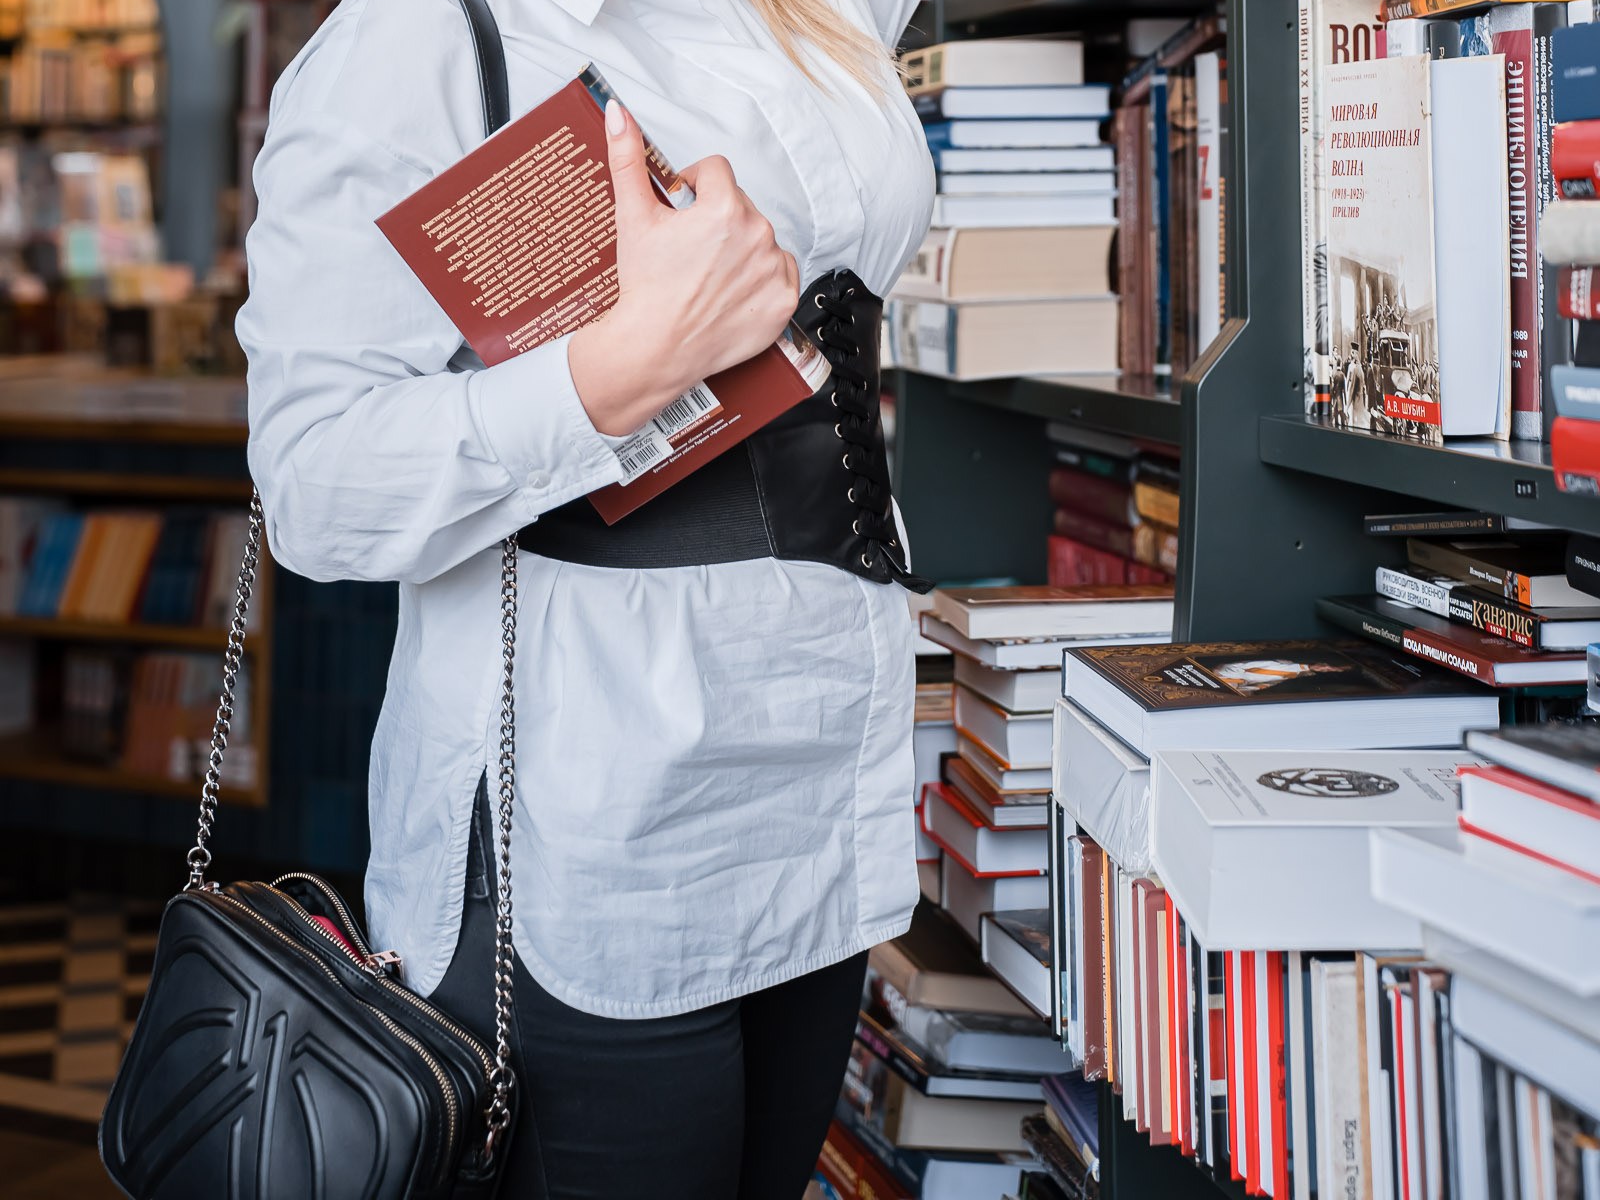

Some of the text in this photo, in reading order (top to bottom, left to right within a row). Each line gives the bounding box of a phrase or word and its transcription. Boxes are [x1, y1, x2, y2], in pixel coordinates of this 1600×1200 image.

[1387, 2, 1413, 20] МАФИЯ
[1299, 8, 1309, 60] ВОЙНЫ
[1301, 96, 1309, 133] ВЕКА
[1330, 103, 1378, 122] МИРОВАЯ
[1330, 128, 1421, 149] РЕВОЛЮЦИОННАЯ
[1541, 94, 1550, 180] принудительное
[420, 207, 451, 231] Аристотель
[455, 193, 471, 206] один
[476, 166, 510, 192] величайших
[507, 143, 541, 169] мыслителей
[539, 125, 570, 148] древности,
[426, 220, 446, 238] ученик
[443, 205, 469, 224] Платона
[471, 180, 505, 205] воспитатель
[503, 158, 535, 183] Александра
[532, 132, 574, 162] Македонского,
[1332, 160, 1364, 177] ВОЛНА
[1508, 60, 1528, 279] ЭНЦИКЛОПЕДИЯ
[433, 218, 477, 253] древнегреческой
[475, 198, 507, 223] философии
[510, 174, 540, 198] оказавший
[538, 158, 564, 179] огромное
[563, 143, 587, 162] влияние
[436, 212, 471, 240] обобщивший
[473, 200, 491, 214] своих
[488, 187, 509, 202] трудах
[507, 177, 522, 190] опыт
[521, 152, 558, 181] классической
[556, 141, 574, 156] эпохи
[462, 221, 488, 242] развитие
[486, 198, 520, 225] европейской
[523, 179, 548, 200] мировой
[544, 162, 575, 183] культуры,
[1332, 206, 1360, 218] ПРИЛИВ
[1387, 399, 1426, 418] А.В. ШУБИН
[1383, 571, 1446, 601] РУКОВОДИТЕЛЬ ВОЕННОЙ
[1383, 583, 1431, 609] РАЗВЕДКИ ВЕРМАХТА
[1450, 605, 1472, 622] АБСХАГЕН
[1472, 600, 1533, 639] Канарис
[1490, 625, 1502, 636] 1935
[1403, 637, 1478, 675] КОГДА ПРИШЛИ СОЛДАТЫ
[1515, 635, 1528, 645] 1945
[1343, 1119, 1357, 1161] Карл
